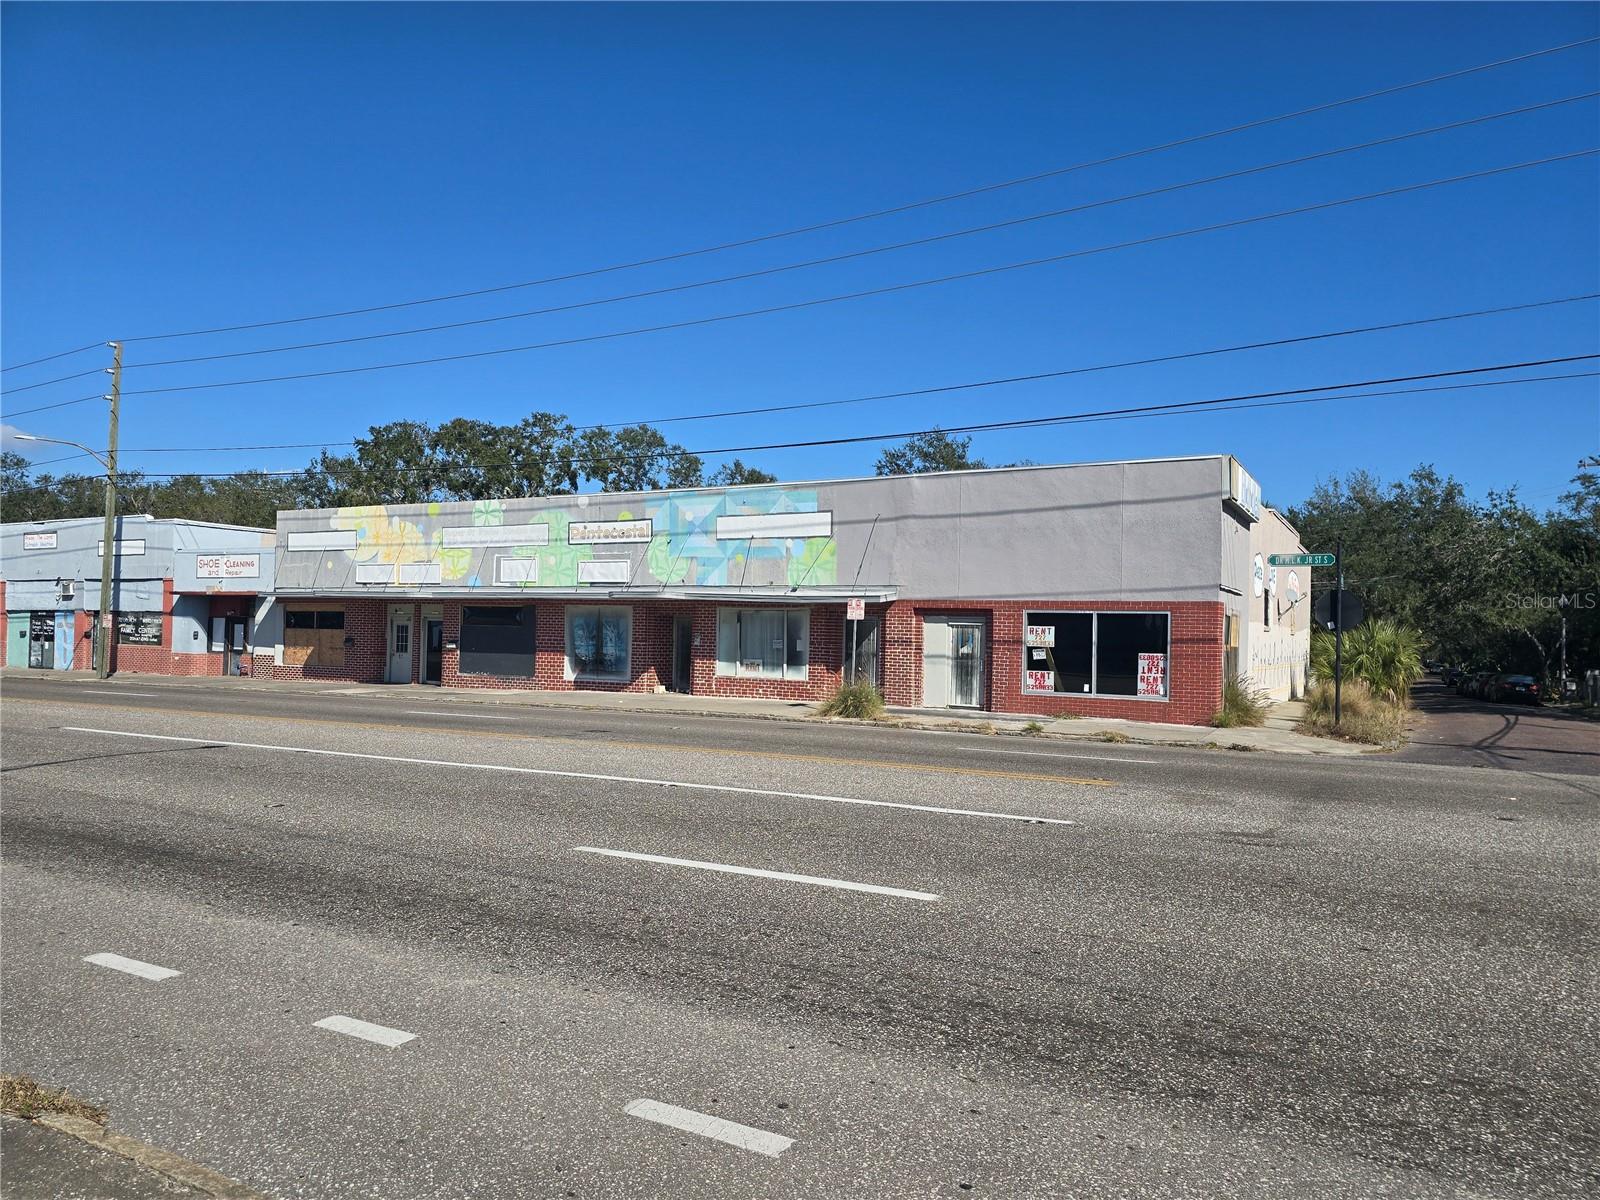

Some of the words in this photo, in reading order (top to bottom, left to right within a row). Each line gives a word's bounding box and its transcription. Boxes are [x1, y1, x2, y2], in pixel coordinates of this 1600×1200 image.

[199, 558, 220, 569] SHOE
[225, 559, 255, 569] CLEANING
[1315, 555, 1321, 564] ST
[1323, 555, 1328, 564] S
[1029, 627, 1051, 636] RENT
[1141, 666, 1166, 675] RENT
[1028, 671, 1052, 680] RENT
[1140, 675, 1165, 684] RENT
